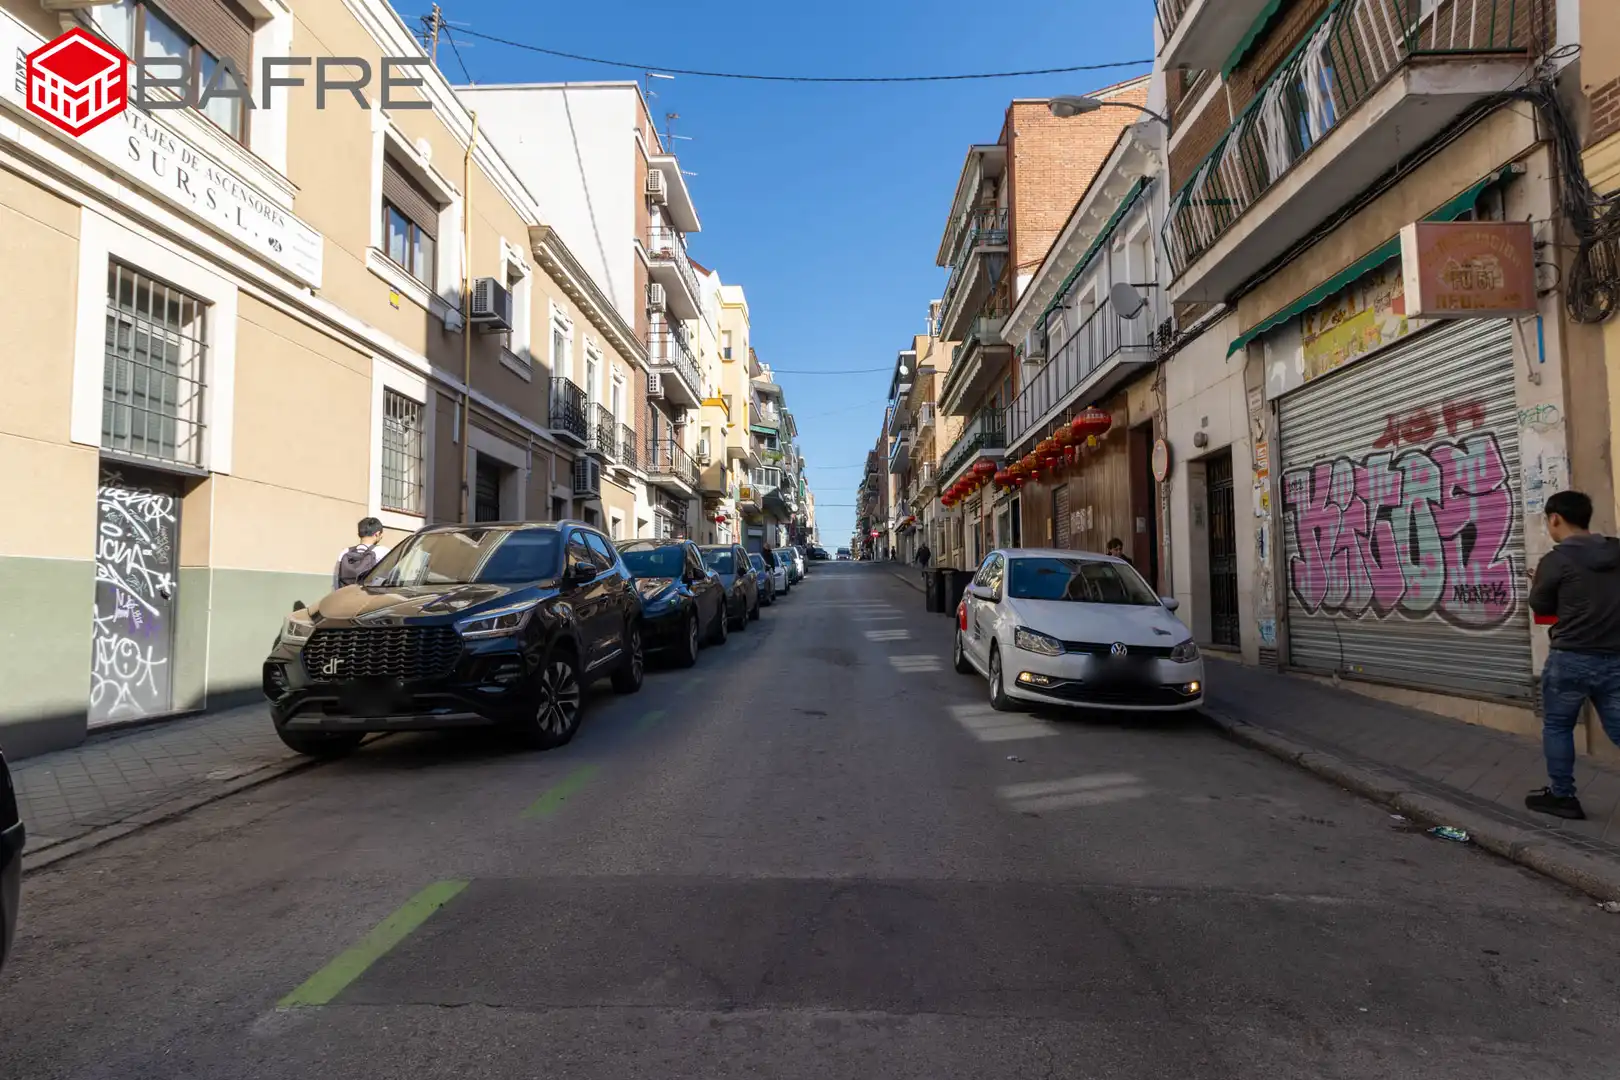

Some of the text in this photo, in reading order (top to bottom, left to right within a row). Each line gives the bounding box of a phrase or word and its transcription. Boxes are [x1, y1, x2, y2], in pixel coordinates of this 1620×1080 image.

[181, 148, 200, 171] DE
[205, 167, 286, 228] ASCENSORES
[323, 658, 345, 674] dr
